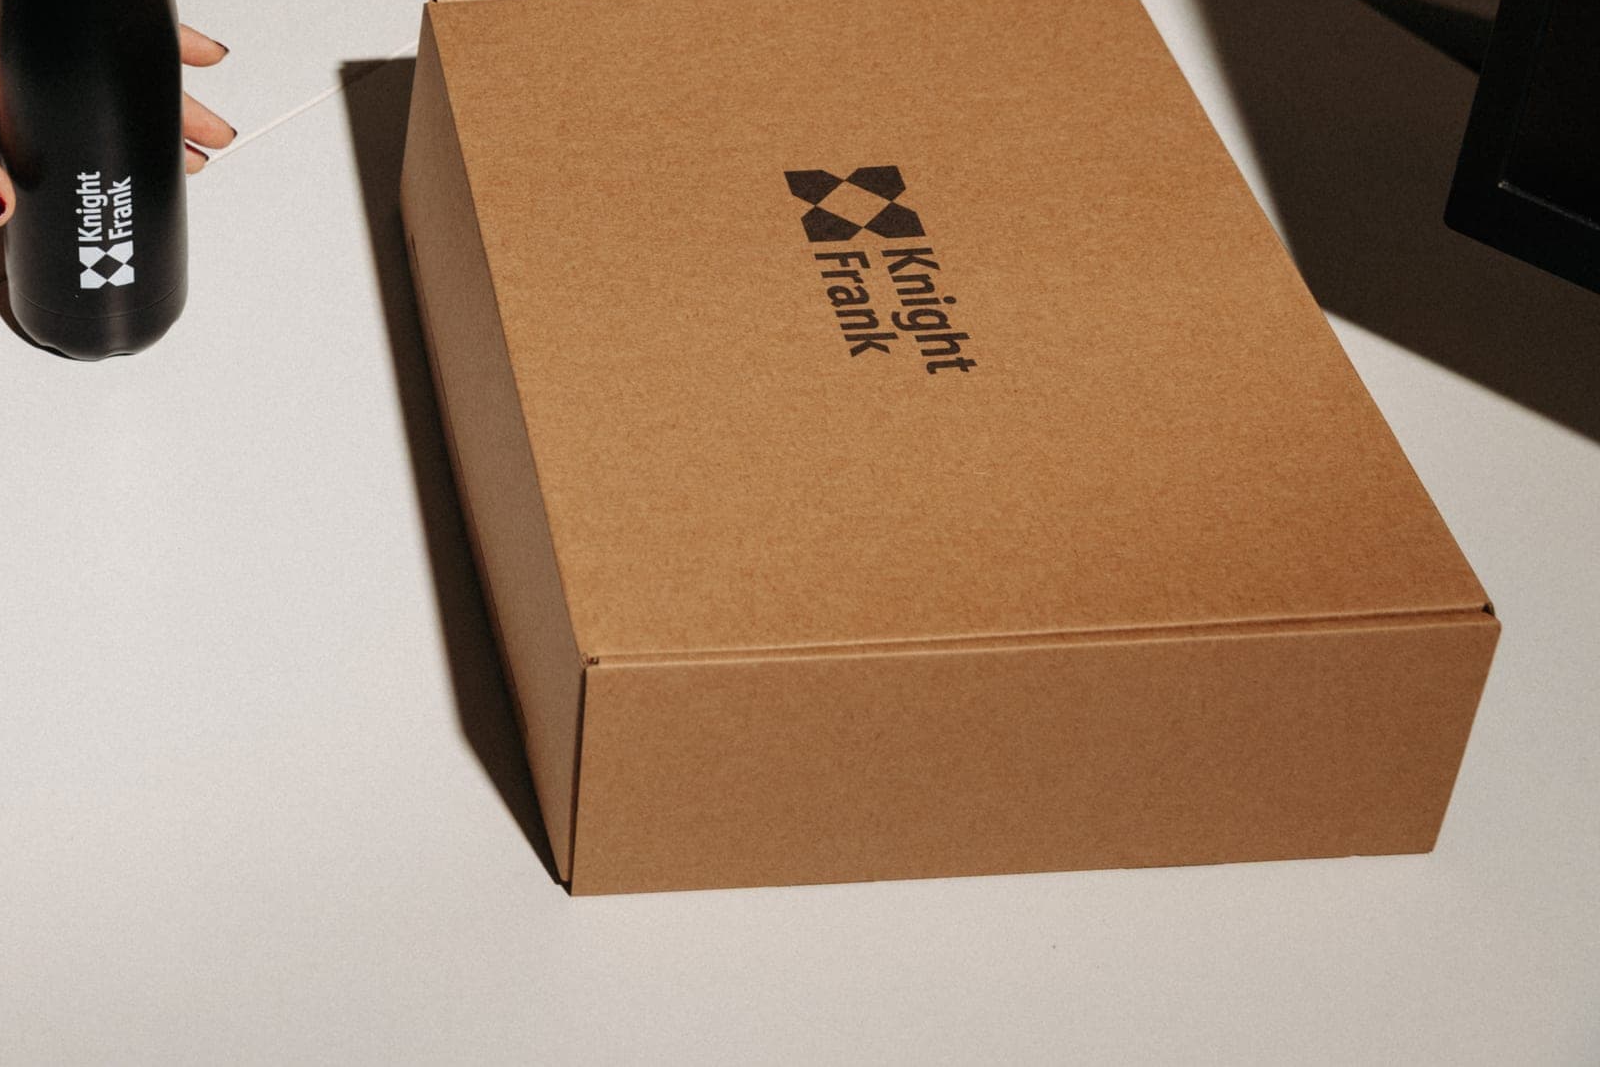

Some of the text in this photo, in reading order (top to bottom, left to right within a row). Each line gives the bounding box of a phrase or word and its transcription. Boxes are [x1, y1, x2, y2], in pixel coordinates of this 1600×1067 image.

[76, 171, 109, 242] Knight
[107, 175, 133, 241] Frank
[814, 251, 899, 357] Frank
[881, 248, 978, 375] Knight
